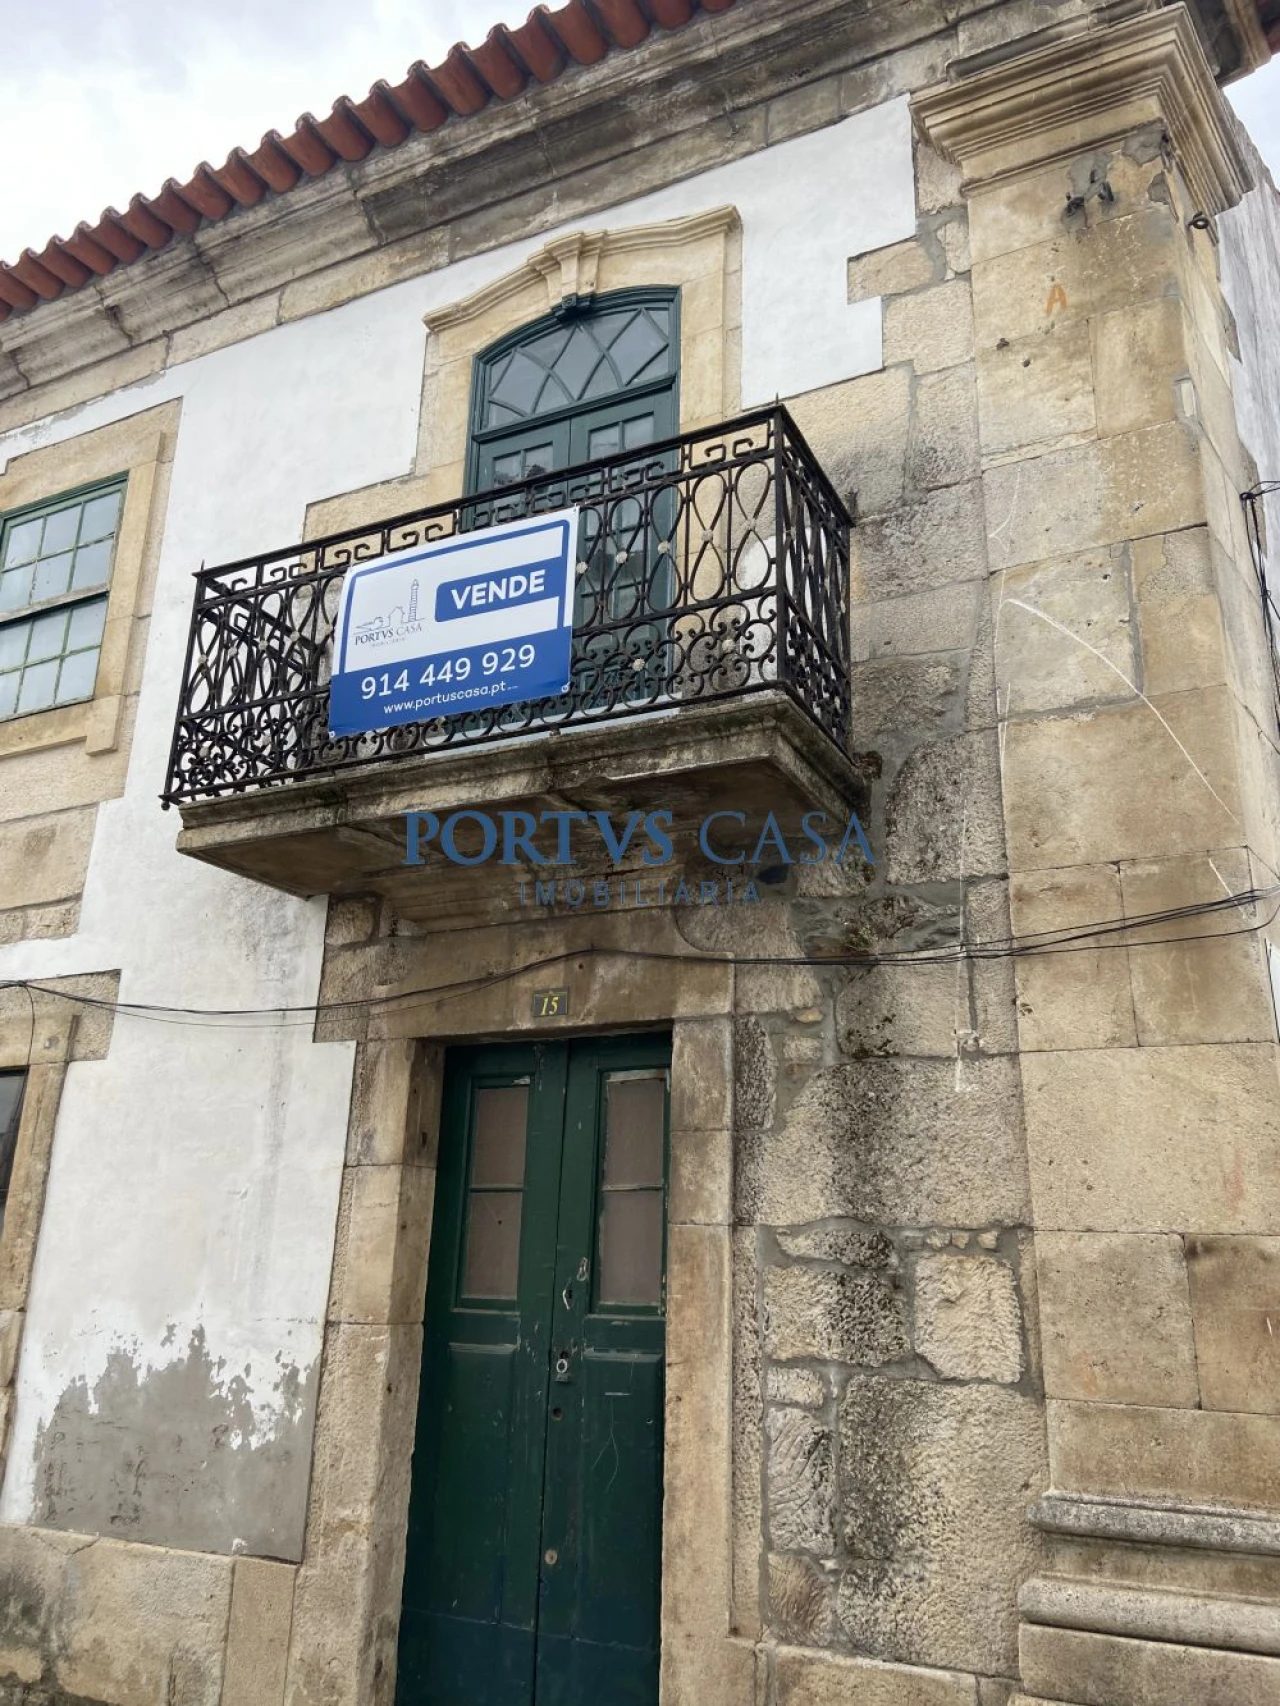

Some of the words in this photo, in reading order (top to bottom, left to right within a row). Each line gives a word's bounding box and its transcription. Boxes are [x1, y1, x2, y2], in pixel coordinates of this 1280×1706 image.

[451, 569, 546, 609] VENDE
[355, 627, 393, 645] PORTVS
[397, 622, 422, 635] CASA
[361, 668, 410, 700] 914
[419, 657, 471, 687] 449
[482, 644, 536, 675] 929
[383, 680, 506, 714] www.portuscasa.pt
[540, 996, 559, 1016] 15
